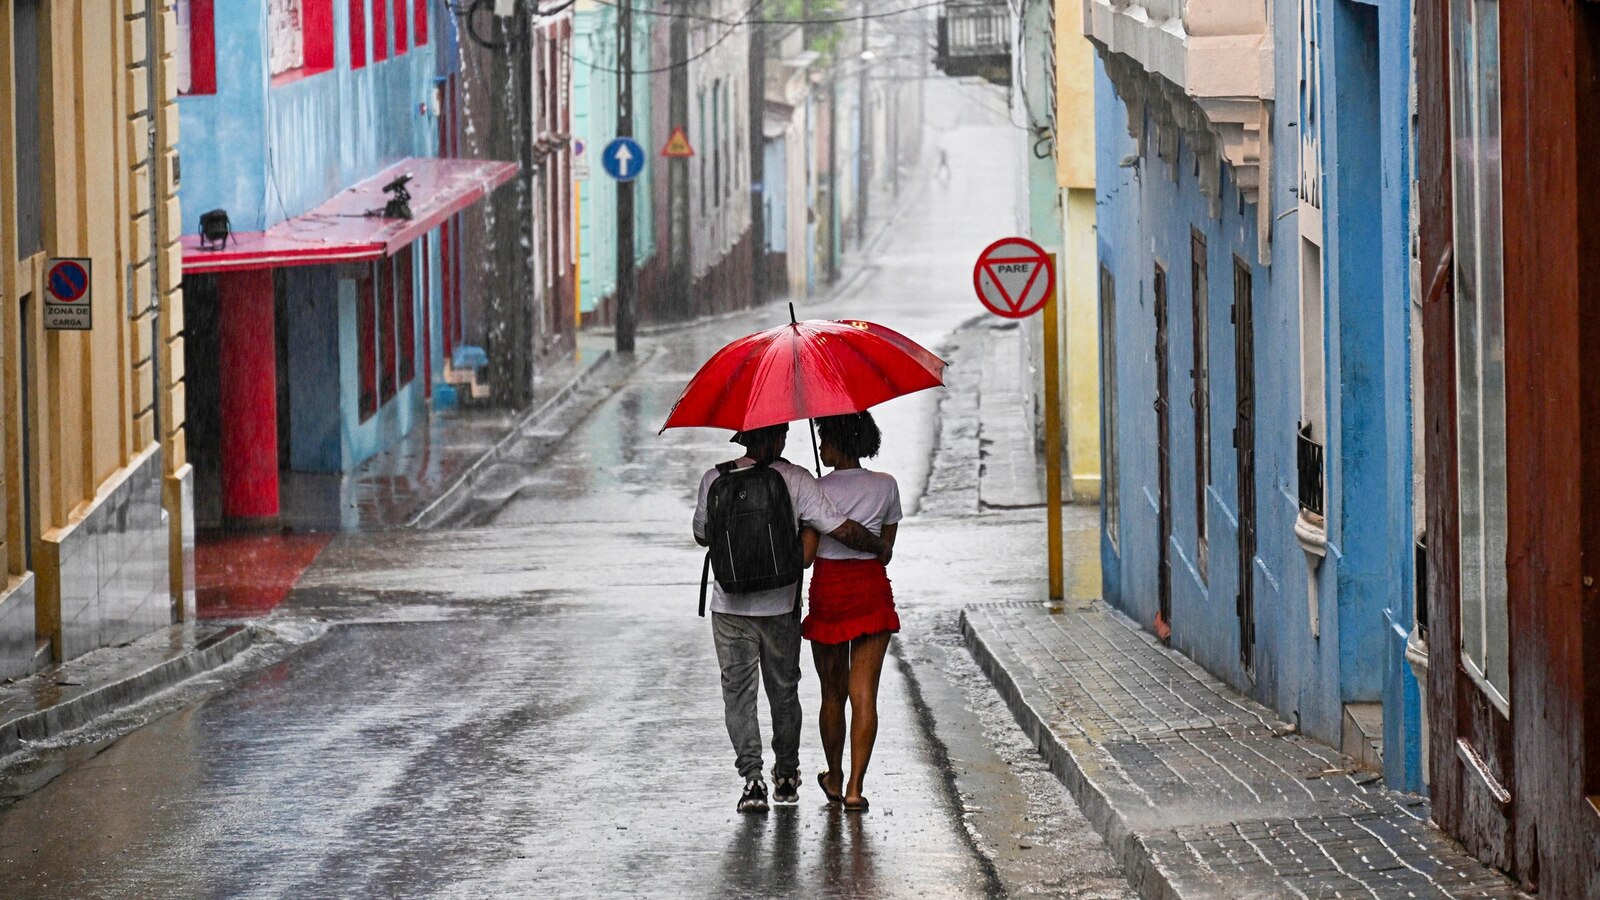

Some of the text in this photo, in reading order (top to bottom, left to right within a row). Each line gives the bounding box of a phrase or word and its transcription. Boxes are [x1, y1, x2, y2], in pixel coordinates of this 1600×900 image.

[998, 264, 1030, 274] PARE
[48, 307, 88, 315] ZONA DE
